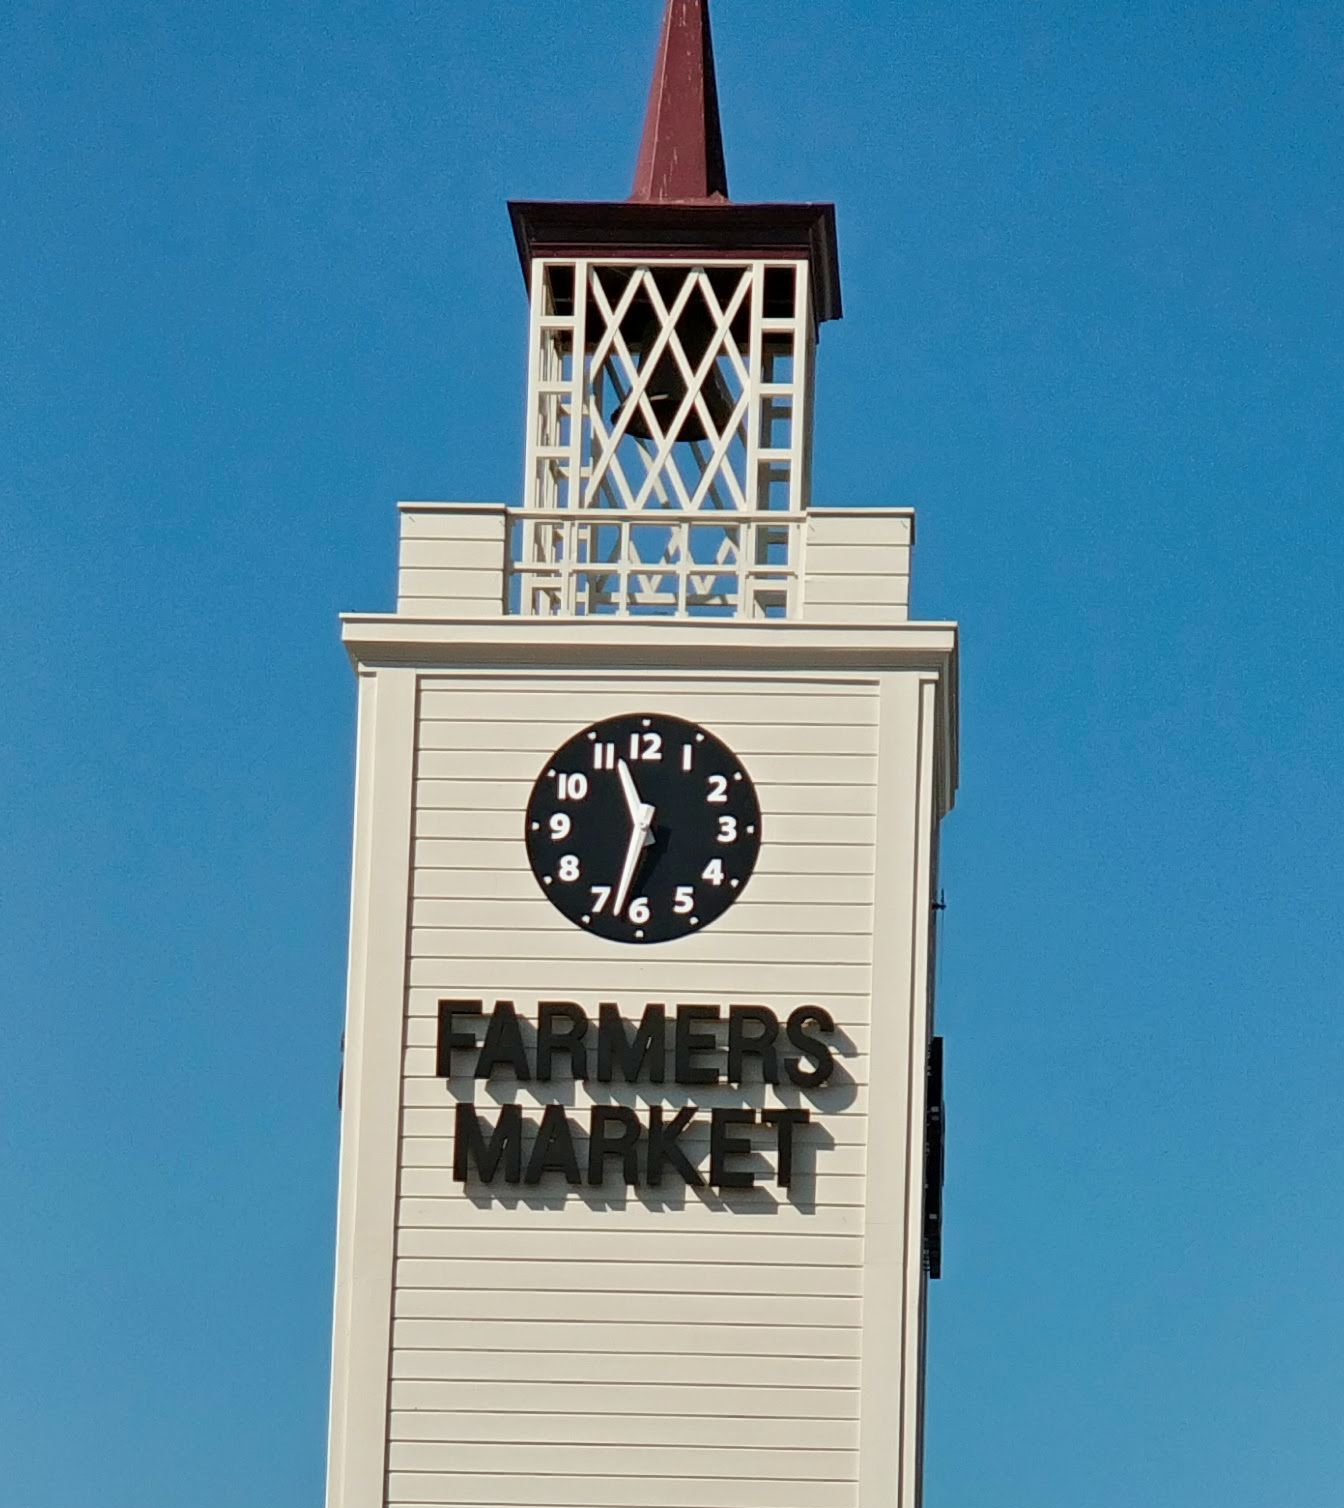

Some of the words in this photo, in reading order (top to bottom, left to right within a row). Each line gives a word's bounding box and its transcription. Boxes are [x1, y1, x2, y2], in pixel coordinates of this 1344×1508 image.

[593, 742, 615, 770] 11
[630, 732, 662, 761] 12
[682, 744, 692, 771] 1
[557, 772, 588, 800] 10
[706, 774, 728, 803] 2
[549, 812, 571, 840] 9
[716, 815, 737, 843] 3
[558, 854, 580, 882] 8
[701, 858, 725, 886] 4
[590, 886, 611, 913] 7
[628, 896, 650, 924] 6
[673, 886, 694, 914] 5
[436, 999, 835, 1088] FARMERS
[453, 1103, 810, 1188] MARKET
